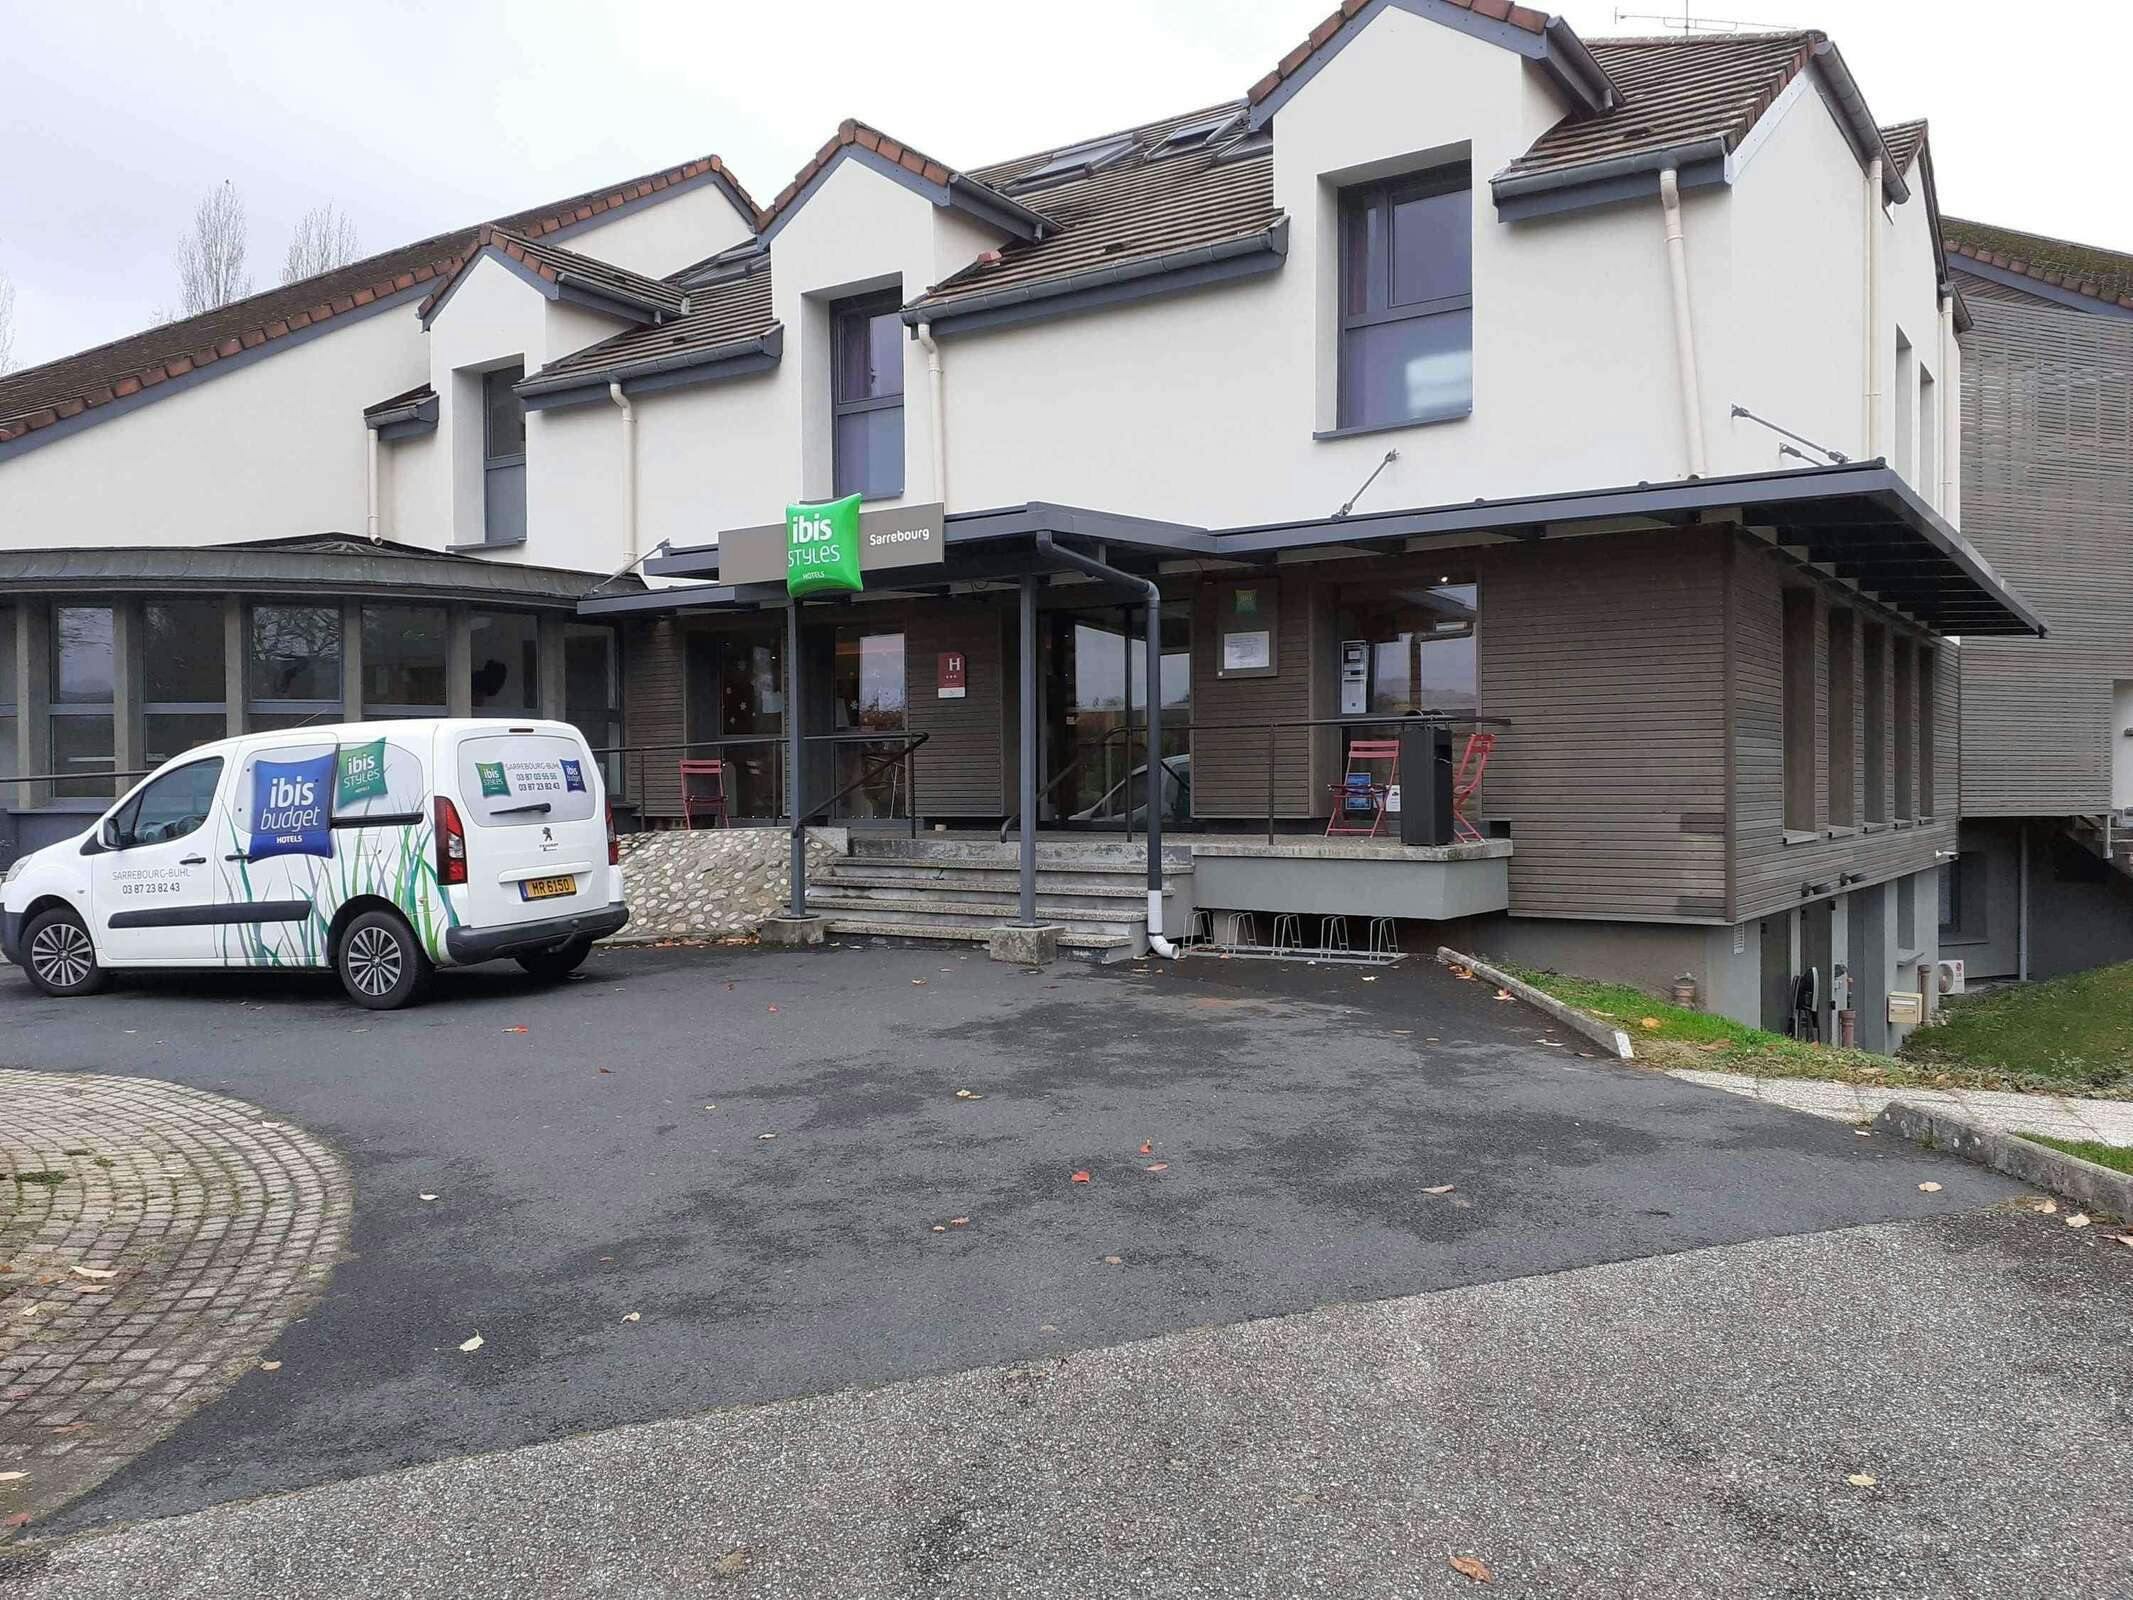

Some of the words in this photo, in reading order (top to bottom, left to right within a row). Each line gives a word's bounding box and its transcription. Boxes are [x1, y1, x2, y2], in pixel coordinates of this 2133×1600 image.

[792, 513, 833, 544] ibis
[869, 528, 930, 546] Sarrebourg
[803, 571, 825, 580] HOTELS
[949, 657, 961, 671] H
[348, 753, 375, 775] ibis
[565, 765, 579, 775] ibis
[483, 768, 500, 779] ibis
[516, 773, 524, 781] 03
[525, 773, 533, 781] 87
[533, 773, 541, 781] 03
[541, 772, 549, 780] 55
[549, 772, 558, 780] 55
[269, 775, 315, 808] ibis
[518, 783, 527, 791] 03
[527, 783, 535, 791] 87
[536, 783, 544, 791] 23
[552, 782, 560, 790] 43
[260, 806, 320, 832] budget
[276, 835, 303, 844] HOTELS
[112, 868, 192, 881] SARREBOURG-BUHL
[122, 885, 132, 895] 03
[134, 884, 144, 894] 87
[146, 883, 156, 893] 23
[157, 883, 168, 893] 82
[170, 882, 180, 892] 43
[547, 878, 570, 893] 6150
